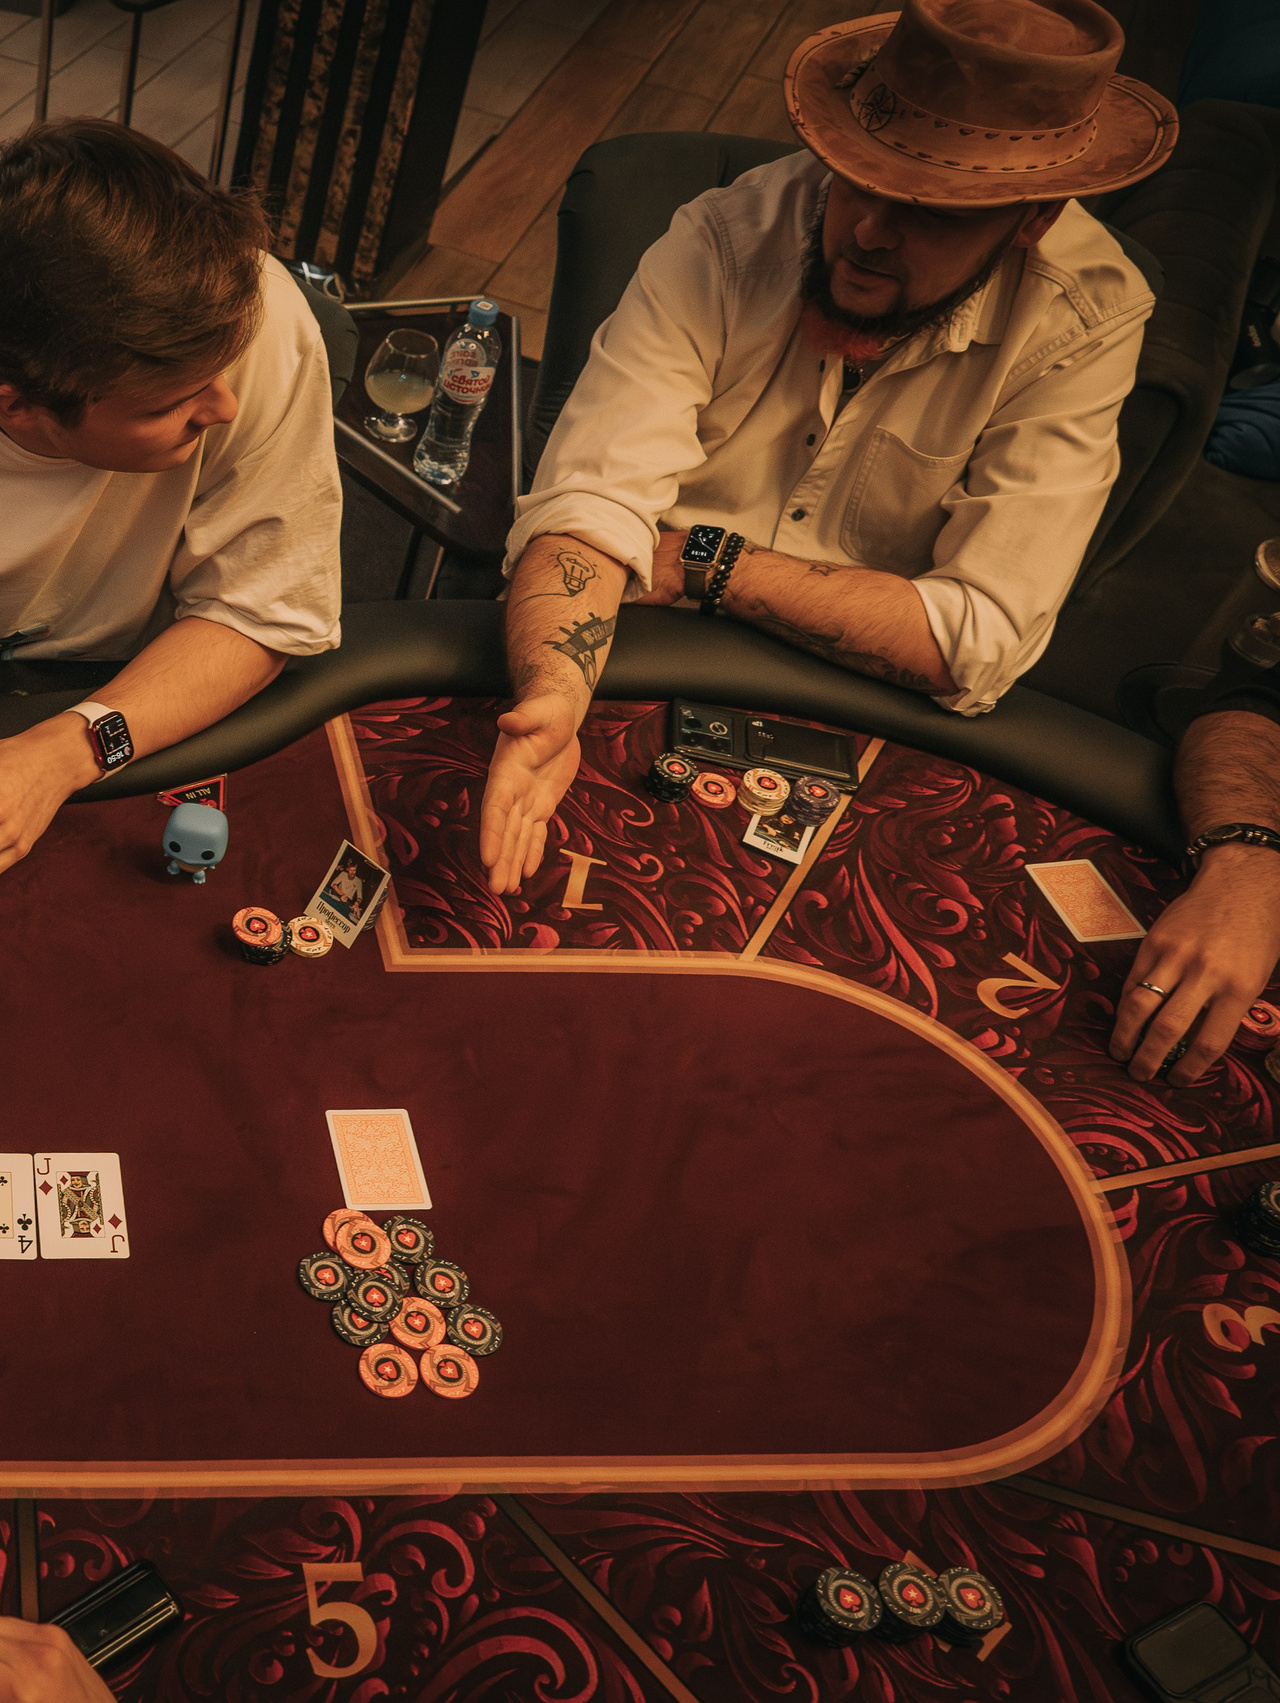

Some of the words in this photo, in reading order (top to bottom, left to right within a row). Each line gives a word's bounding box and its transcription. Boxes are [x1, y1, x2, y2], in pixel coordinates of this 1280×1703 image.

[185, 792, 197, 800] IN
[195, 787, 211, 797] ALL
[316, 901, 351, 934] Профессор
[36, 1157, 52, 1176] J
[17, 1235, 34, 1254] 4
[110, 1234, 125, 1253] J
[301, 1562, 378, 1678] 5
